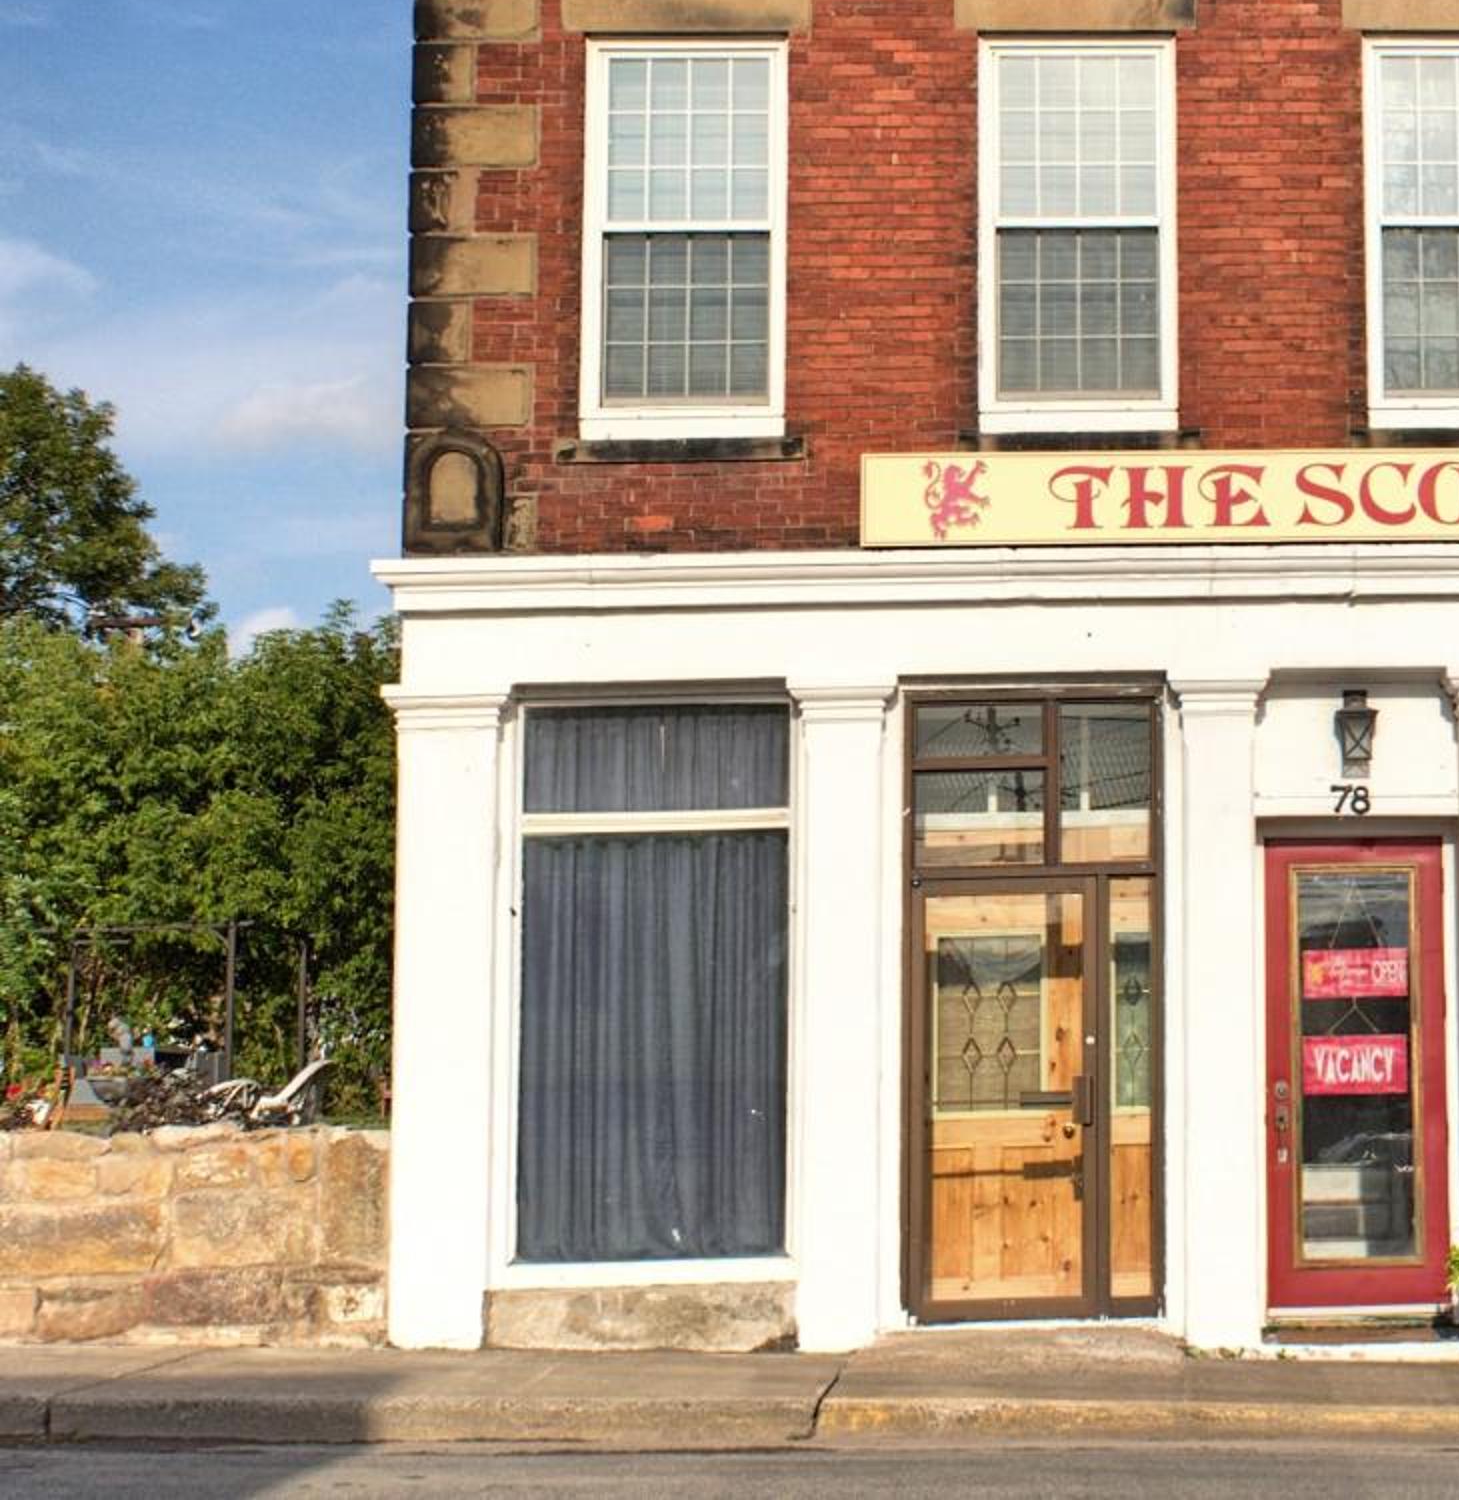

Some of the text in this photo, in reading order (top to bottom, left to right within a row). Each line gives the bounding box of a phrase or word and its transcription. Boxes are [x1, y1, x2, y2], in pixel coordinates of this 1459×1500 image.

[1047, 463, 1271, 529] THE
[1329, 784, 1371, 815] 78
[1370, 959, 1407, 987] OPEN
[1312, 1046, 1395, 1084] VACANCY
